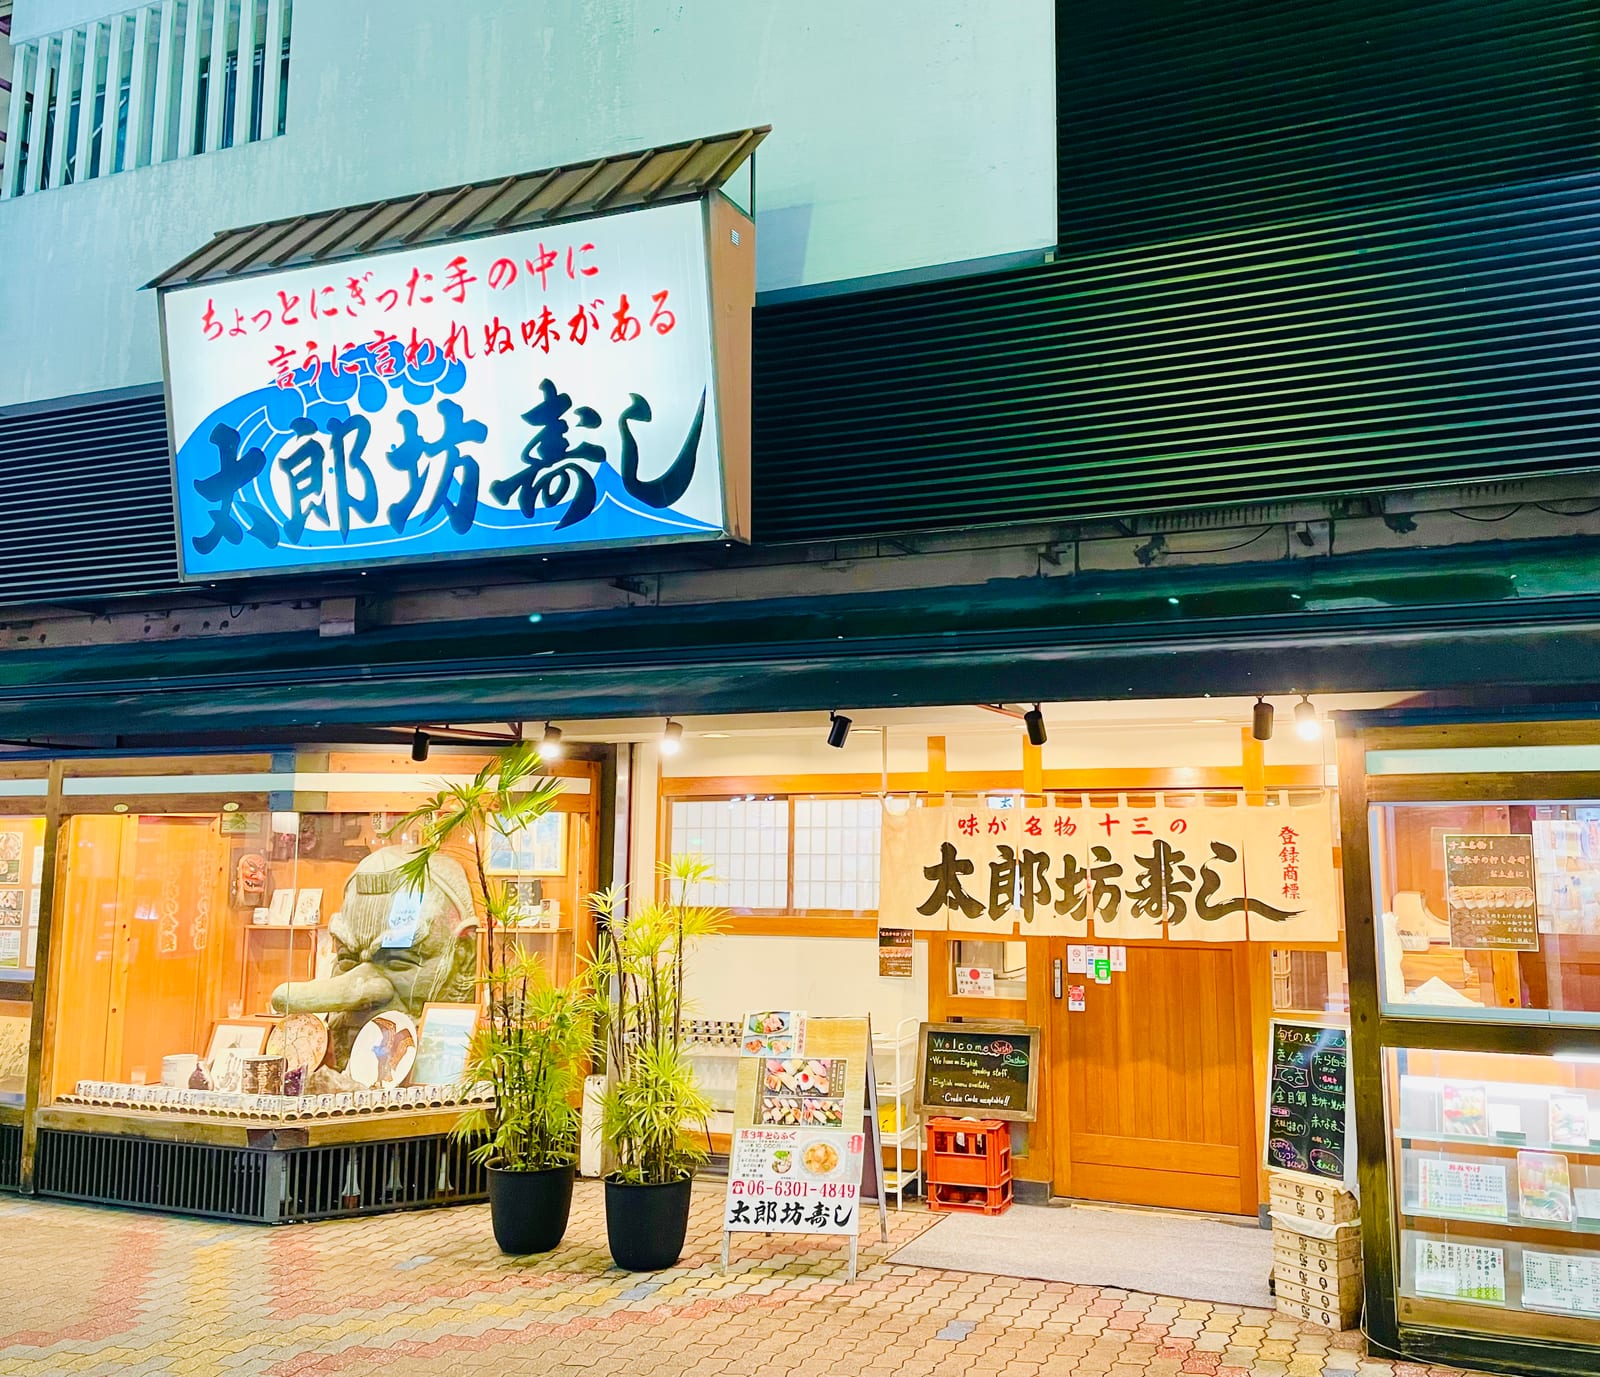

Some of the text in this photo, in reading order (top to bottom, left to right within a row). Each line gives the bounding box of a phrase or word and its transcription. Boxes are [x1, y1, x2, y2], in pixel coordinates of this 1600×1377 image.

[202, 241, 599, 342] ちょっとにぎった手の中に
[267, 289, 678, 390] 言うに言われぬ味がある
[192, 378, 706, 556] 太郎坊寿し
[916, 838, 1307, 926] 太郎坊寿し
[1278, 825, 1301, 900] 登録商標
[933, 1037, 989, 1052] Welcome
[729, 1200, 853, 1228] 太郎坊寿し
